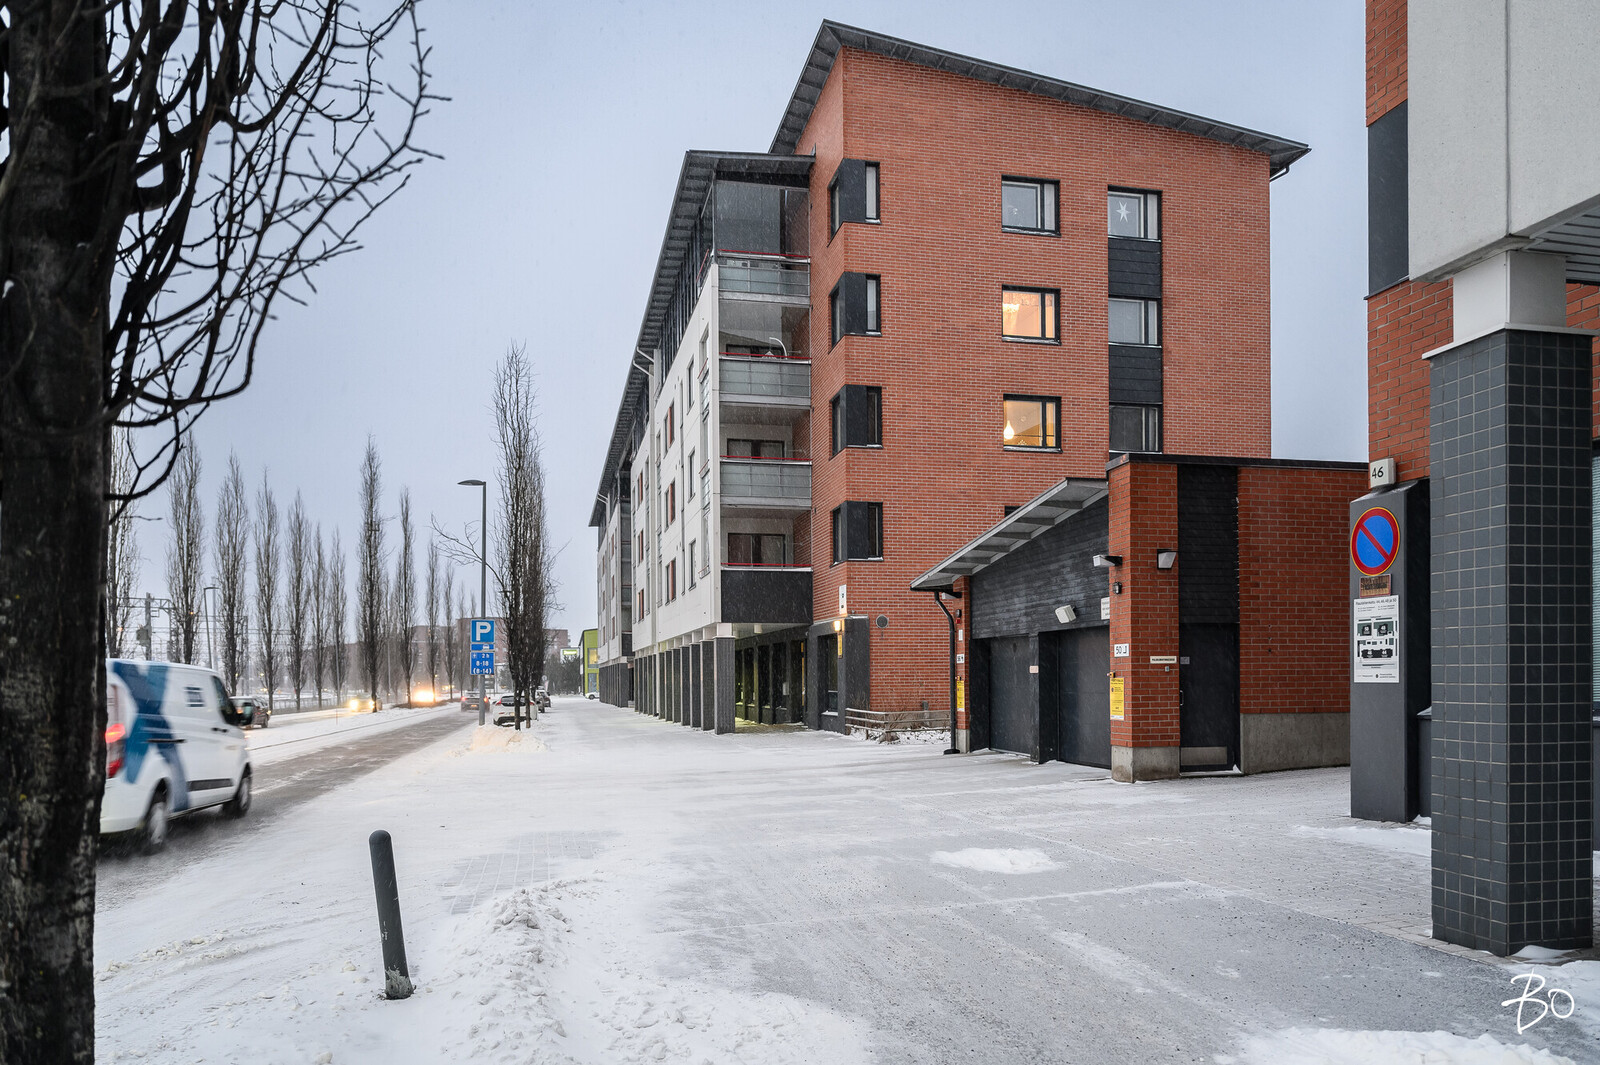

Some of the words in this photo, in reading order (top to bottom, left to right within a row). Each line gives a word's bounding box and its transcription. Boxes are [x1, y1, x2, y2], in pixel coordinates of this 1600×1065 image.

[1371, 466, 1384, 479] 46
[476, 621, 491, 641] P
[1115, 645, 1122, 655] 50
